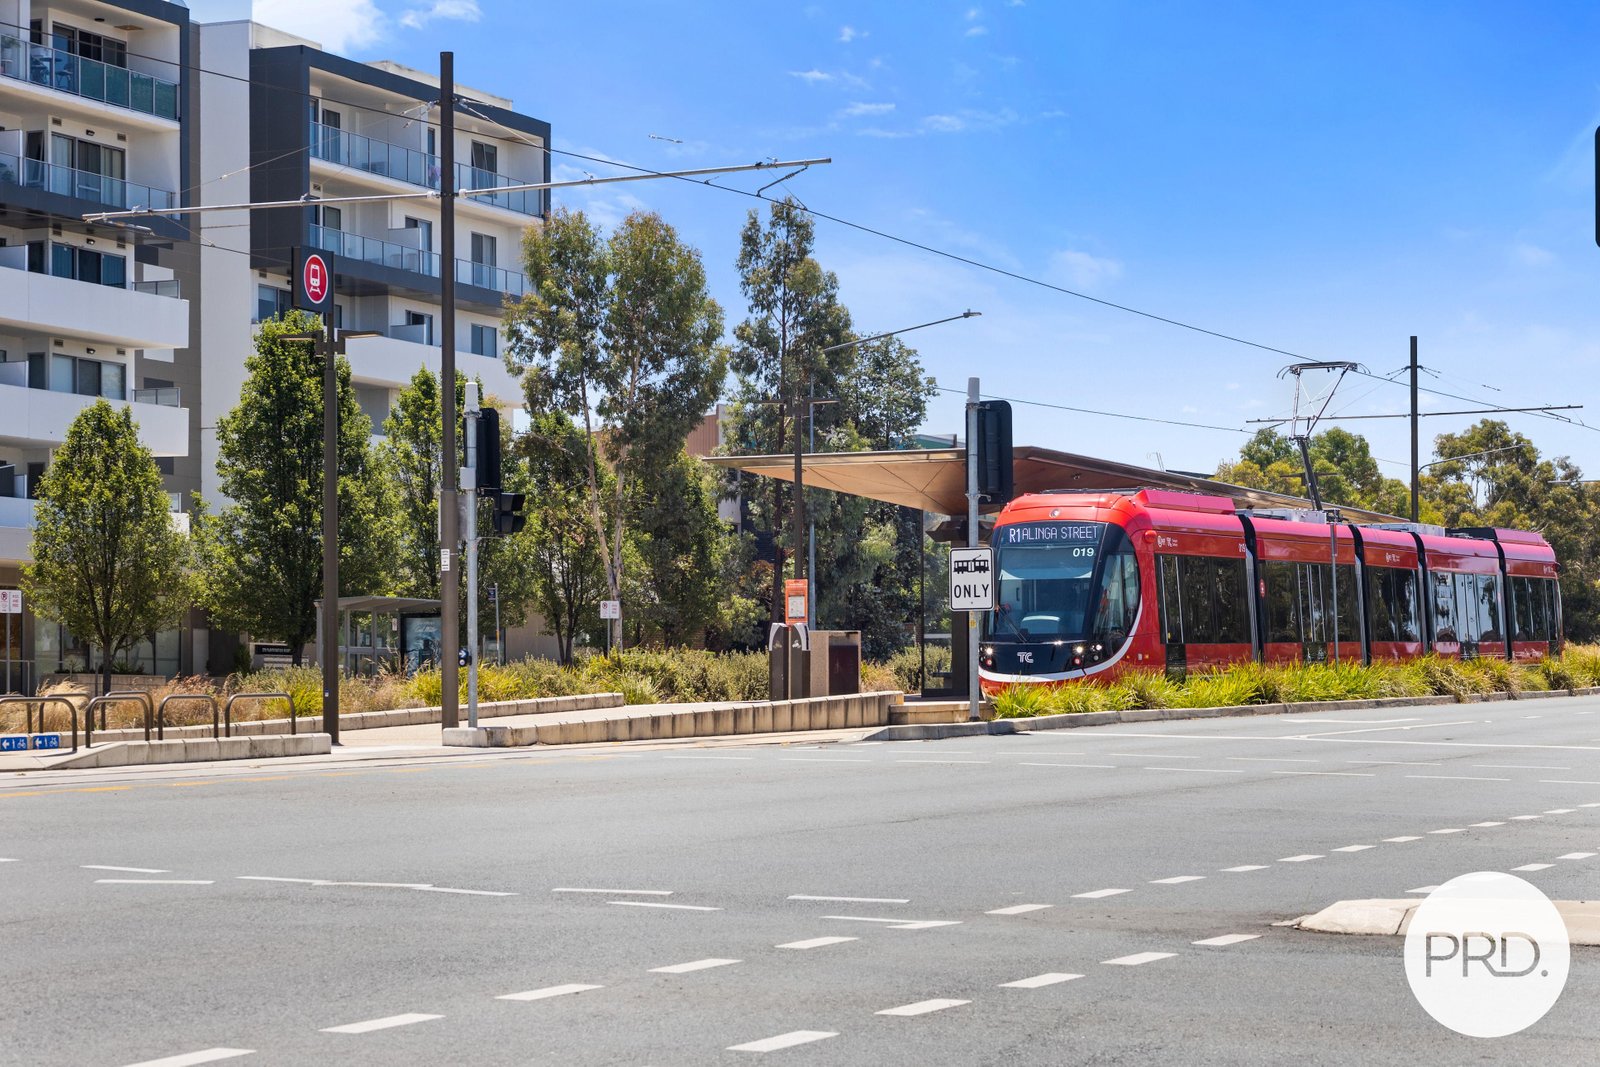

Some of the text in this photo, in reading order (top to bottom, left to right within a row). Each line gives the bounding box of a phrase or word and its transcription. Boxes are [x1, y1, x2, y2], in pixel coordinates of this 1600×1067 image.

[1009, 525, 1098, 543] R1 ALINGA STREET
[1072, 547, 1095, 557] 019
[954, 583, 990, 598] ONLY
[1017, 651, 1034, 664] TC
